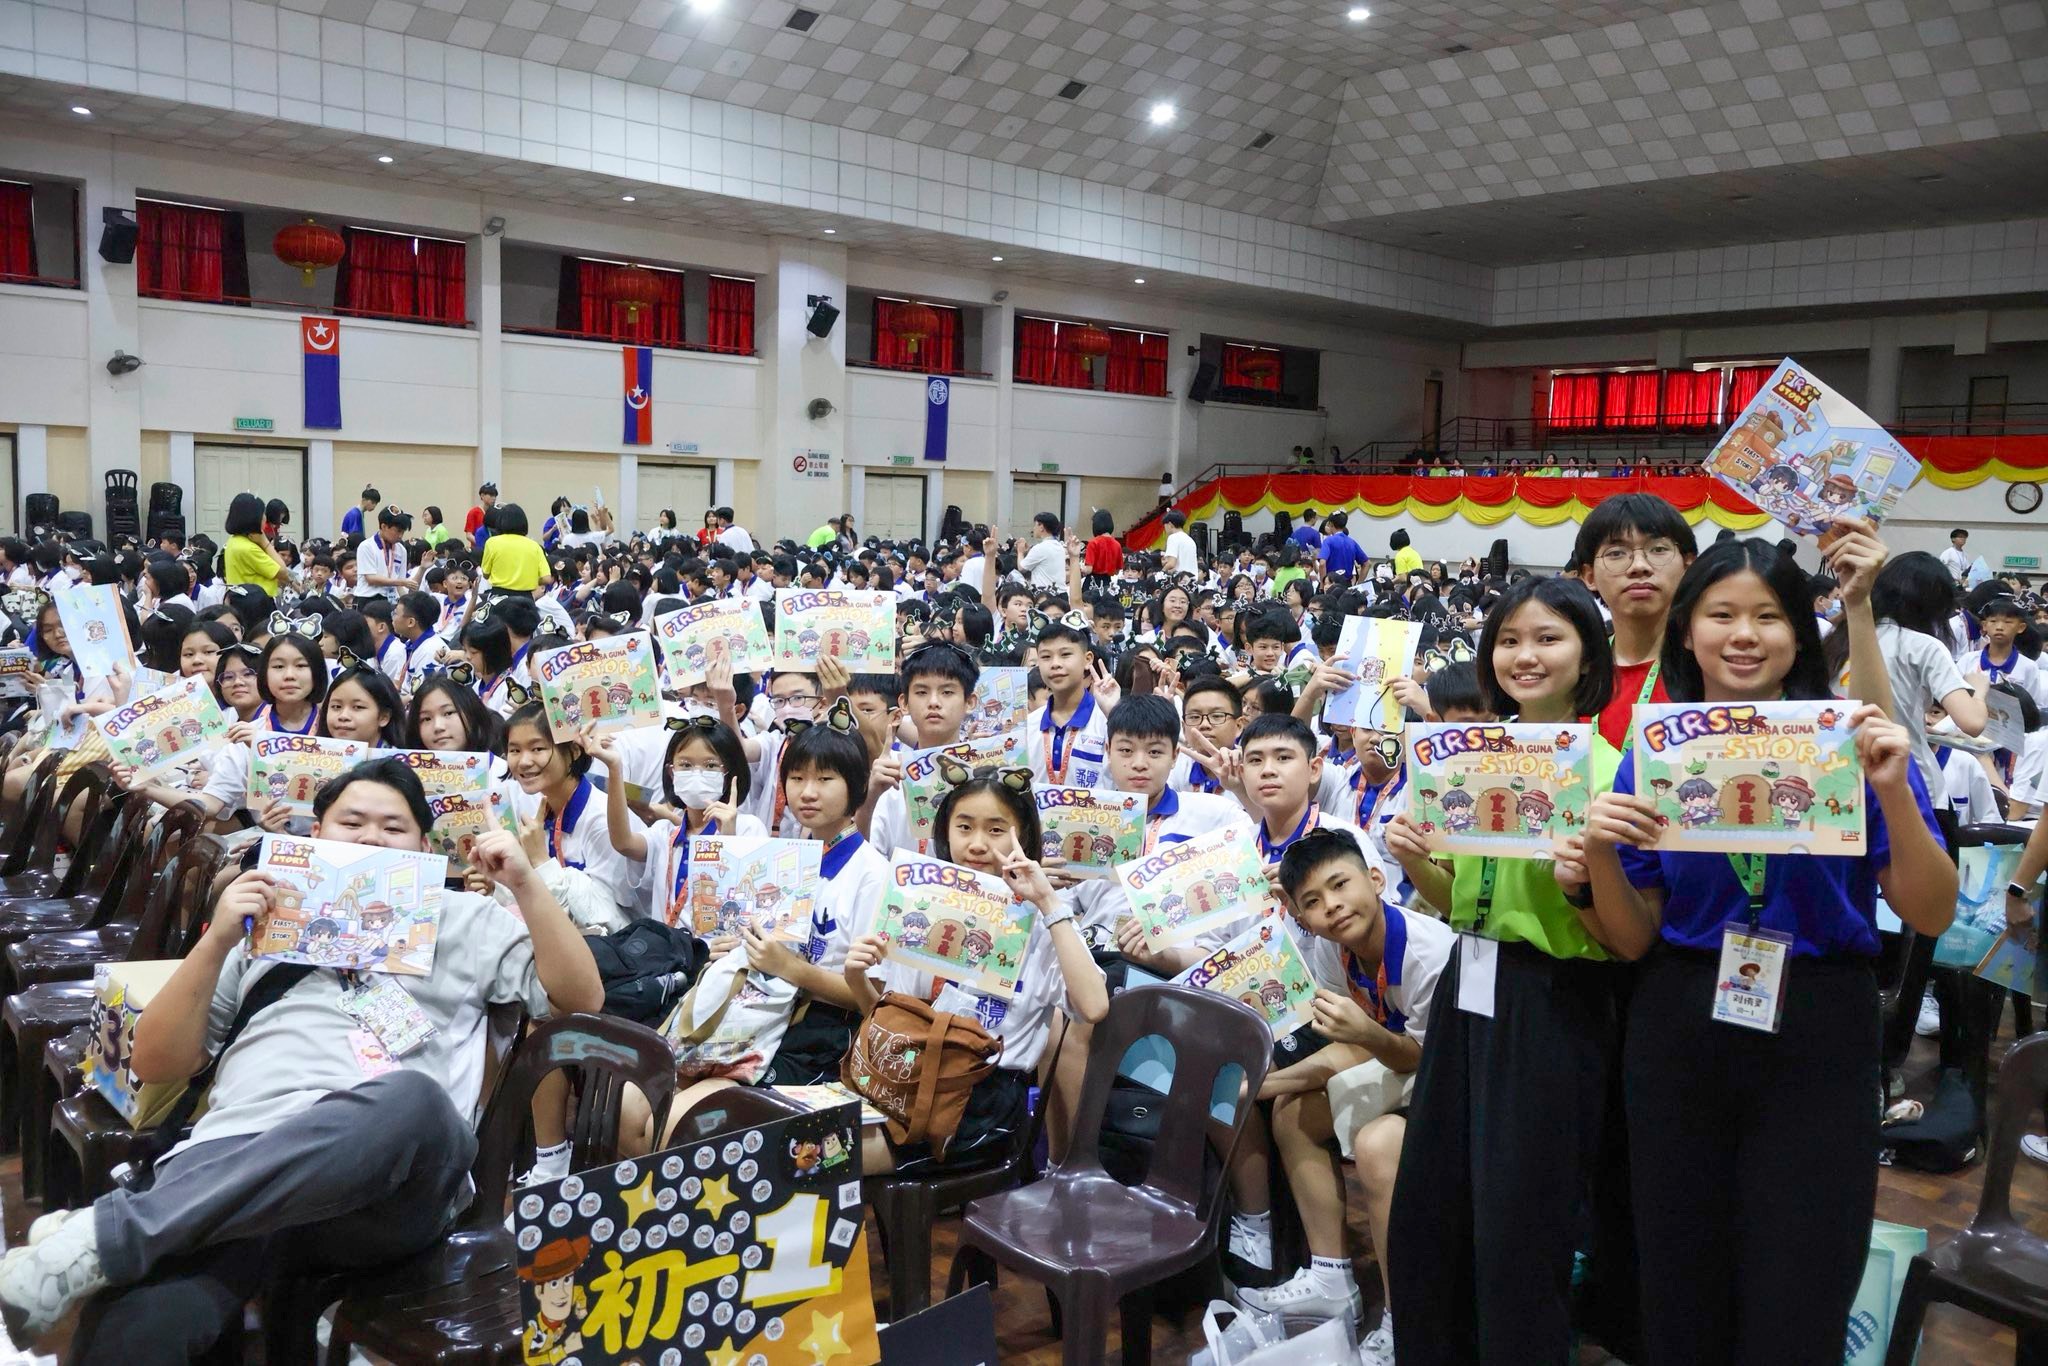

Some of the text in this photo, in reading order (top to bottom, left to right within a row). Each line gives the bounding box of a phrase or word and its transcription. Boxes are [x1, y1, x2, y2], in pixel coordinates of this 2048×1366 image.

[239, 420, 265, 428] KELUAR
[1736, 457, 1753, 470] STORY
[1744, 447, 1760, 459] FIRST
[782, 591, 843, 615] FIRST
[663, 603, 714, 638] FIRST
[825, 608, 888, 628] STORY
[541, 643, 595, 681] FIRST
[580, 660, 648, 678] STORY
[104, 695, 157, 737] FIRST
[147, 700, 210, 726] STORY
[1644, 705, 1757, 752] FIRST
[1782, 724, 1815, 735] GUNA
[257, 736, 317, 757] FIRST
[986, 750, 1003, 758] GUNA
[1414, 726, 1505, 766] FIRST
[1526, 744, 1553, 754] GUNA
[1725, 736, 1849, 773] STORY
[295, 752, 352, 774] STOR
[1480, 753, 1582, 787] STORY
[429, 794, 463, 820] RST
[1036, 789, 1090, 810] IRST
[1070, 808, 1138, 835] STORY
[272, 840, 315, 857] FIRST
[695, 841, 723, 853] FIRST
[696, 852, 719, 860] STORY
[273, 855, 306, 865] STORY
[1127, 843, 1190, 890] FIRST
[1176, 852, 1250, 878] STORY
[895, 863, 976, 892] FIRST
[987, 892, 1008, 905] GUNA
[947, 891, 1024, 935] STORY
[1246, 943, 1264, 957] GUNA
[1183, 948, 1230, 988] RST
[1222, 952, 1291, 989] STORY
[741, 1193, 843, 1308] 1
[1313, 1260, 1333, 1268] FOON
